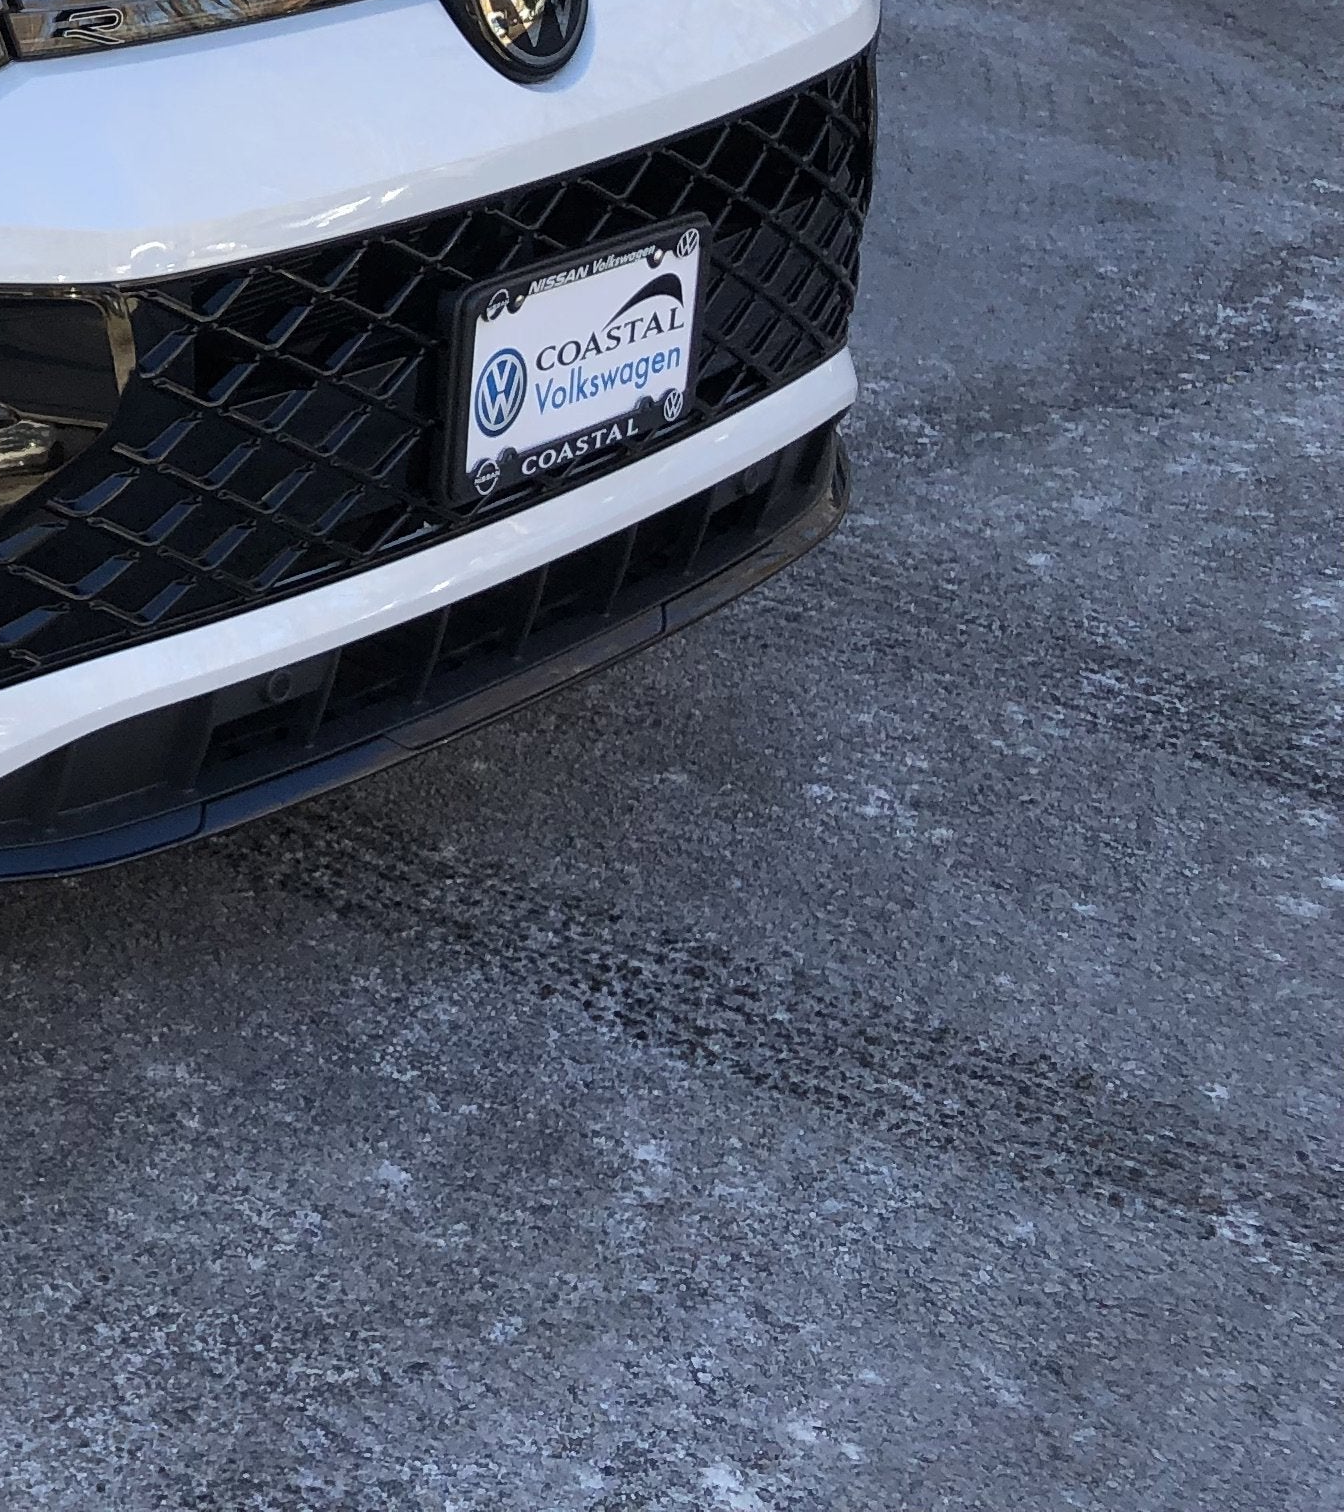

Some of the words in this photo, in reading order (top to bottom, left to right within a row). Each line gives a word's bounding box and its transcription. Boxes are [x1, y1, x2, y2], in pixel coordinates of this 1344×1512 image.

[528, 264, 590, 295] NISSAN
[592, 245, 656, 274] Volkswagen
[535, 306, 685, 371] COASTAL
[535, 346, 682, 416] Volkswagen
[521, 418, 640, 475] COASTAL
